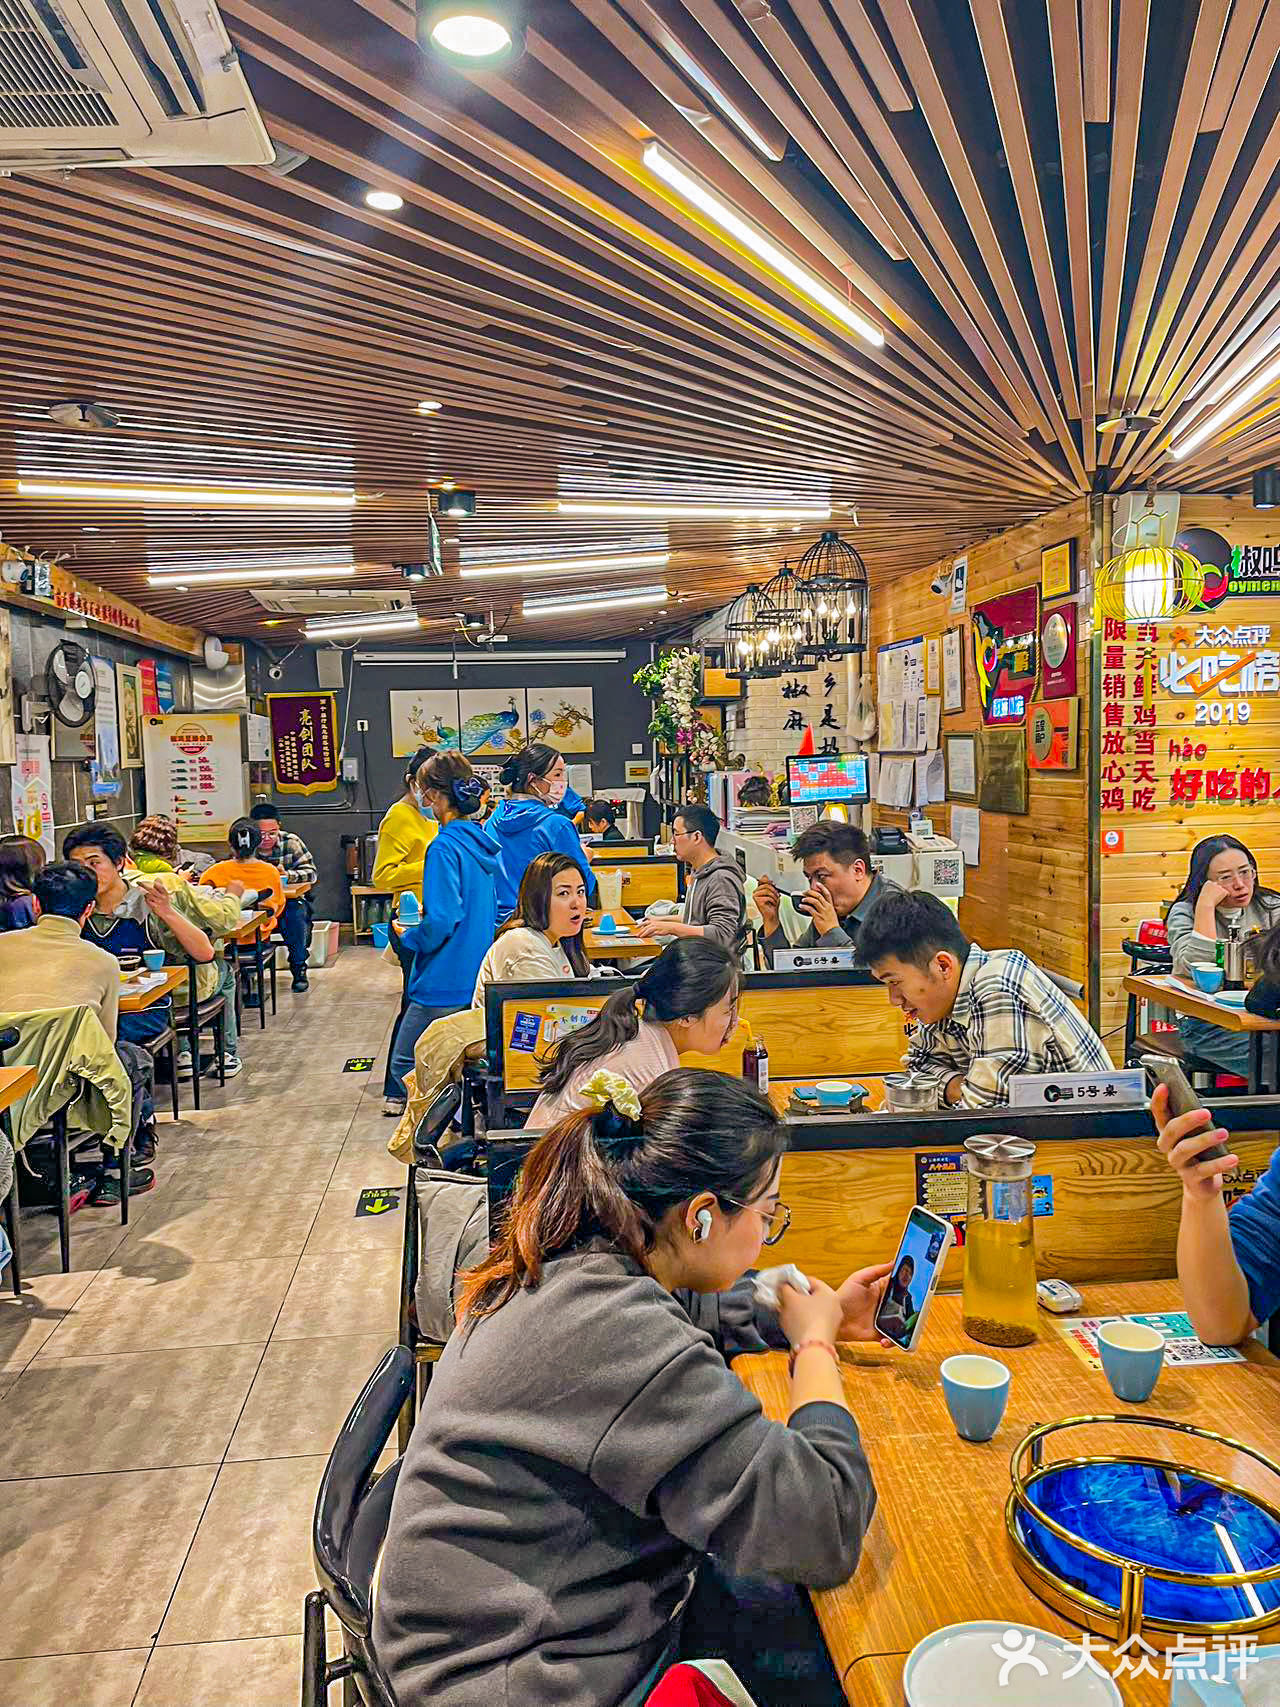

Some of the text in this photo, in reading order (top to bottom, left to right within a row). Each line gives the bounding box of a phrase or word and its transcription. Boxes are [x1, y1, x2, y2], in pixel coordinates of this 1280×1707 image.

[1195, 625, 1270, 648] 大众点评
[1159, 650, 1280, 693] 必吃榜
[1101, 617, 1127, 812] 限量销售放心鸡
[1195, 703, 1250, 722] 2019
[1169, 767, 1280, 801] 好吃的
[1077, 1084, 1118, 1098] 5号桌
